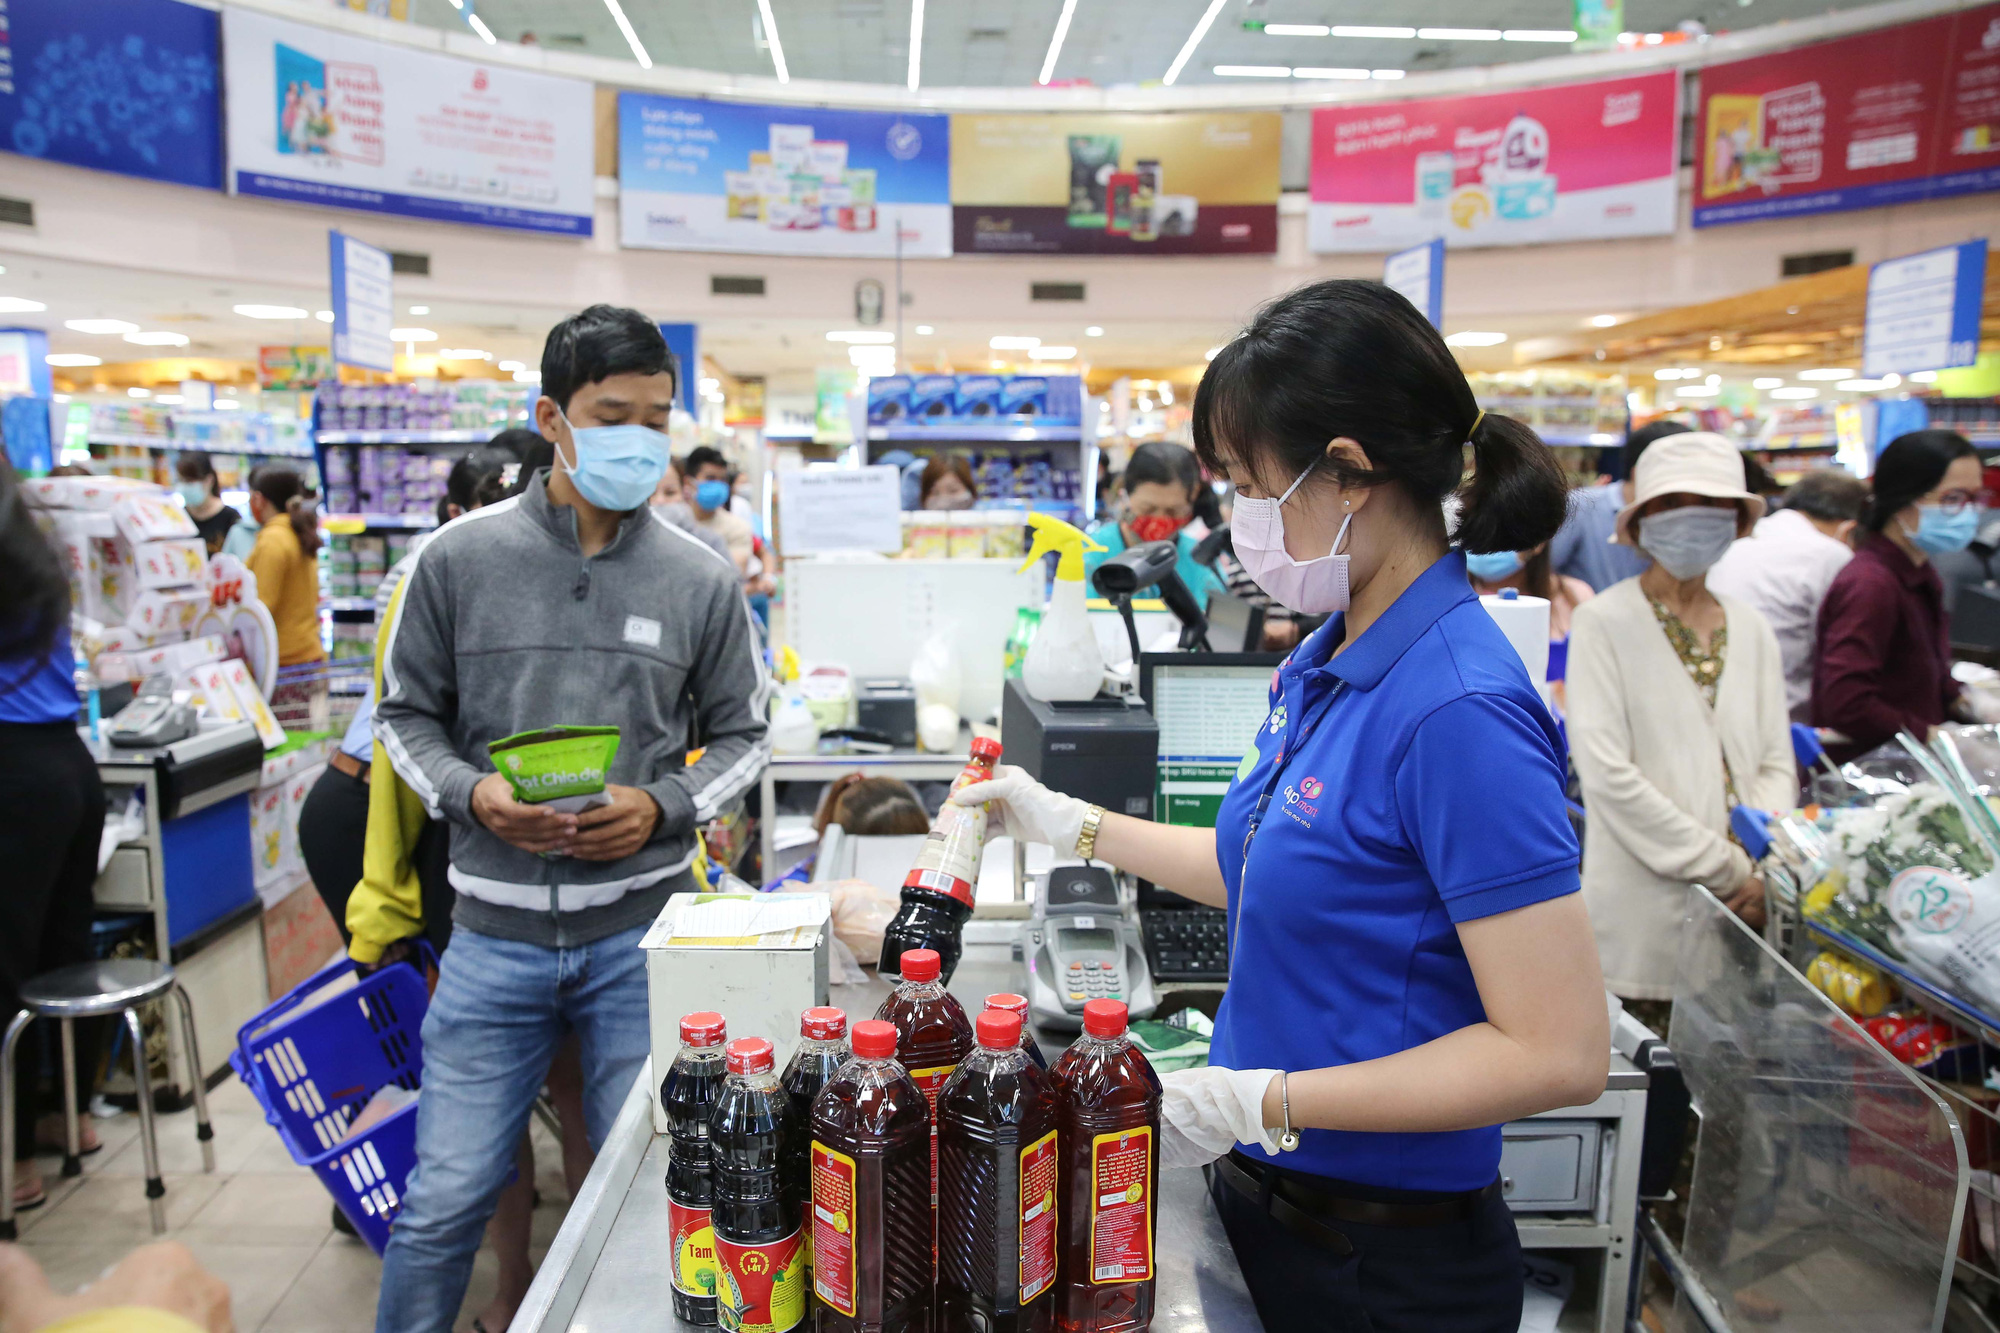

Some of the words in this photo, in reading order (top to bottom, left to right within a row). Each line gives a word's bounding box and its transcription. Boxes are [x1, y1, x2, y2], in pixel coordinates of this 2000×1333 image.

[1050, 743, 1076, 751] EPSON
[1908, 875, 1949, 920] 25
[689, 1244, 712, 1258] Tam
